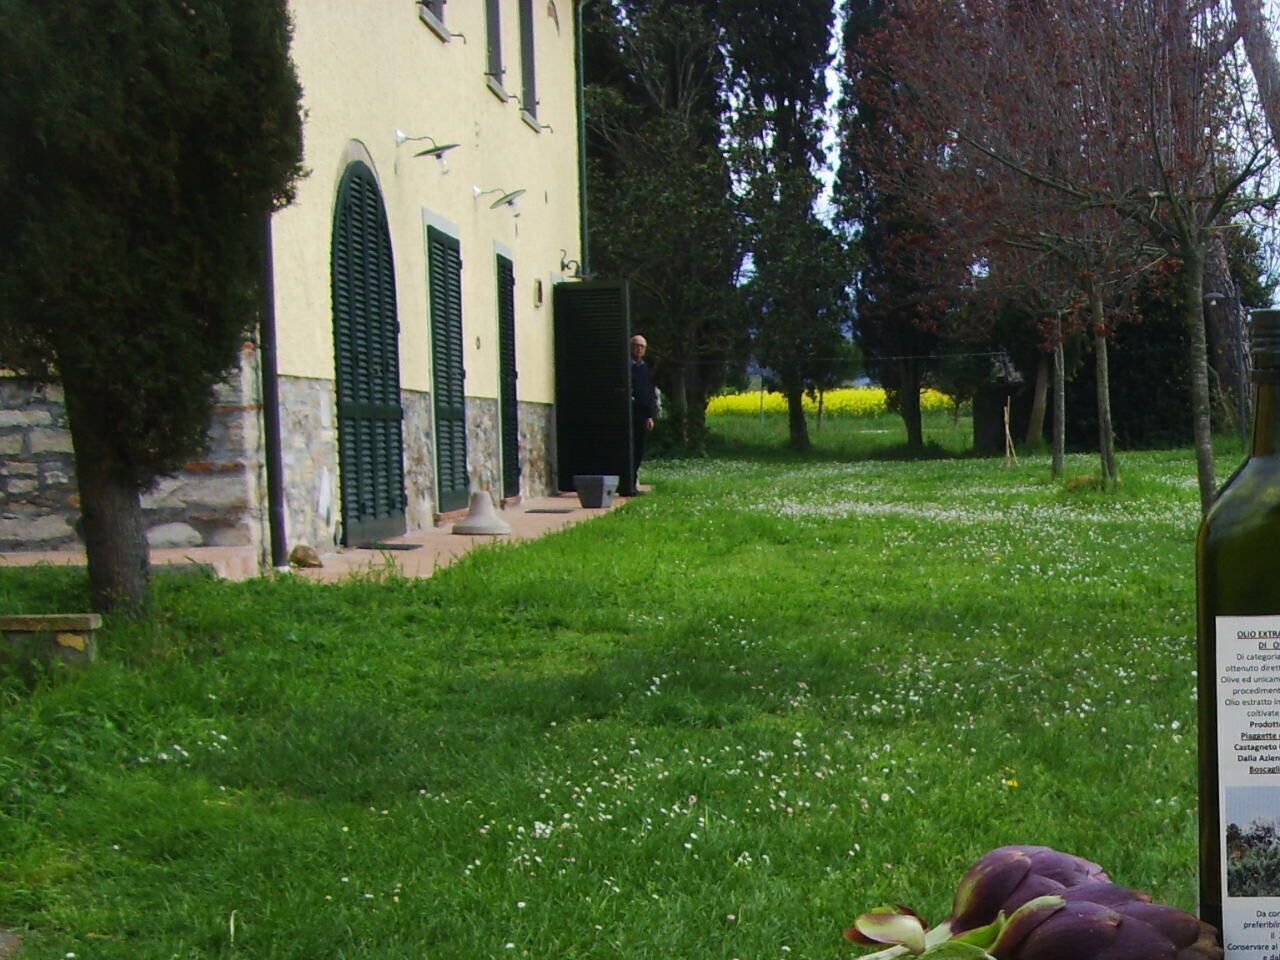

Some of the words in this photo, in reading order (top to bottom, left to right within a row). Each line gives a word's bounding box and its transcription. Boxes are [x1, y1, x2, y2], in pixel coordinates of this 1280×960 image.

[1237, 630, 1257, 639] OLIO
[1258, 641, 1267, 650] DI
[1236, 653, 1244, 661] Di
[1225, 698, 1240, 706] Olio
[1242, 698, 1272, 706] estratto
[1247, 709, 1280, 717] coltivate
[1234, 743, 1277, 752] Castagneto
[1256, 910, 1266, 918] Da
[1227, 943, 1270, 951] Conservare
[1271, 943, 1278, 951] al
[1269, 953, 1280, 960] dal
